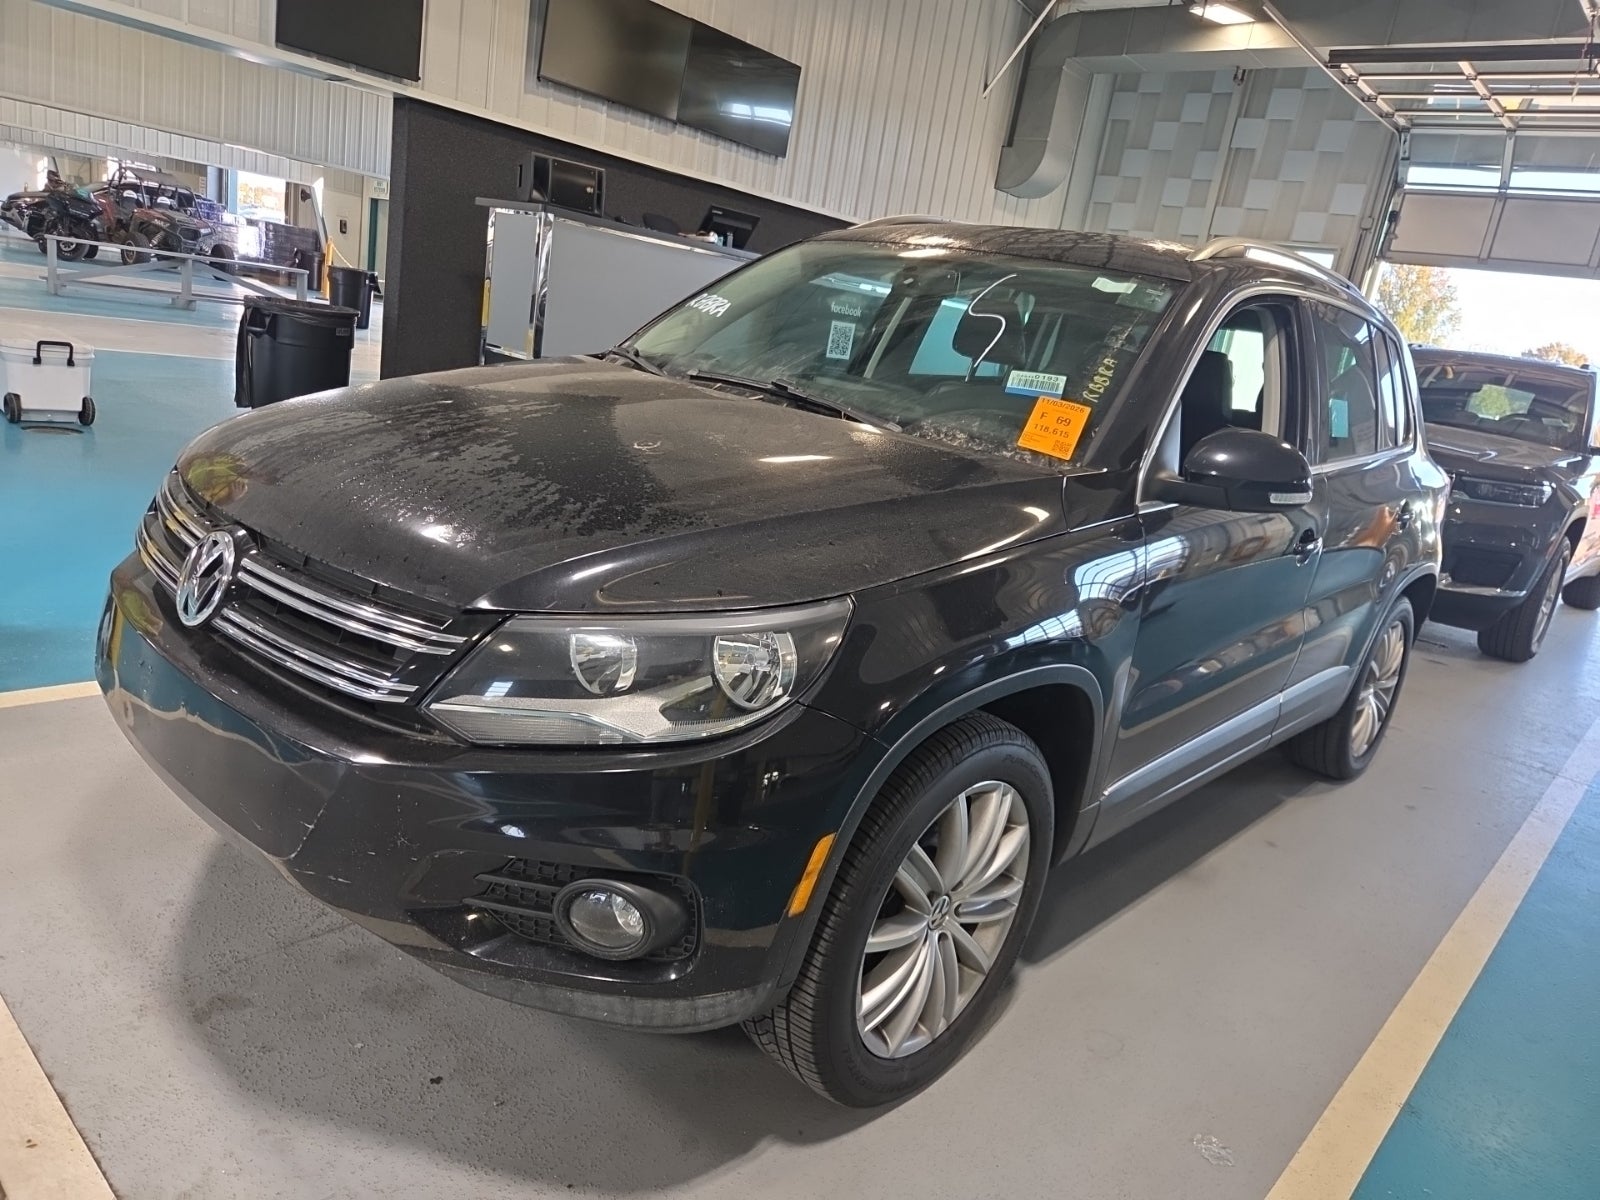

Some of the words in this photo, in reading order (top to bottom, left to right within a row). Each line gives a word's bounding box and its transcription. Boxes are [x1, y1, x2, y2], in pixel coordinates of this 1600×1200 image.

[831, 301, 862, 317] facebook
[1083, 358, 1117, 402] RBBRA
[1040, 411, 1048, 420] F
[1056, 415, 1072, 427] 69
